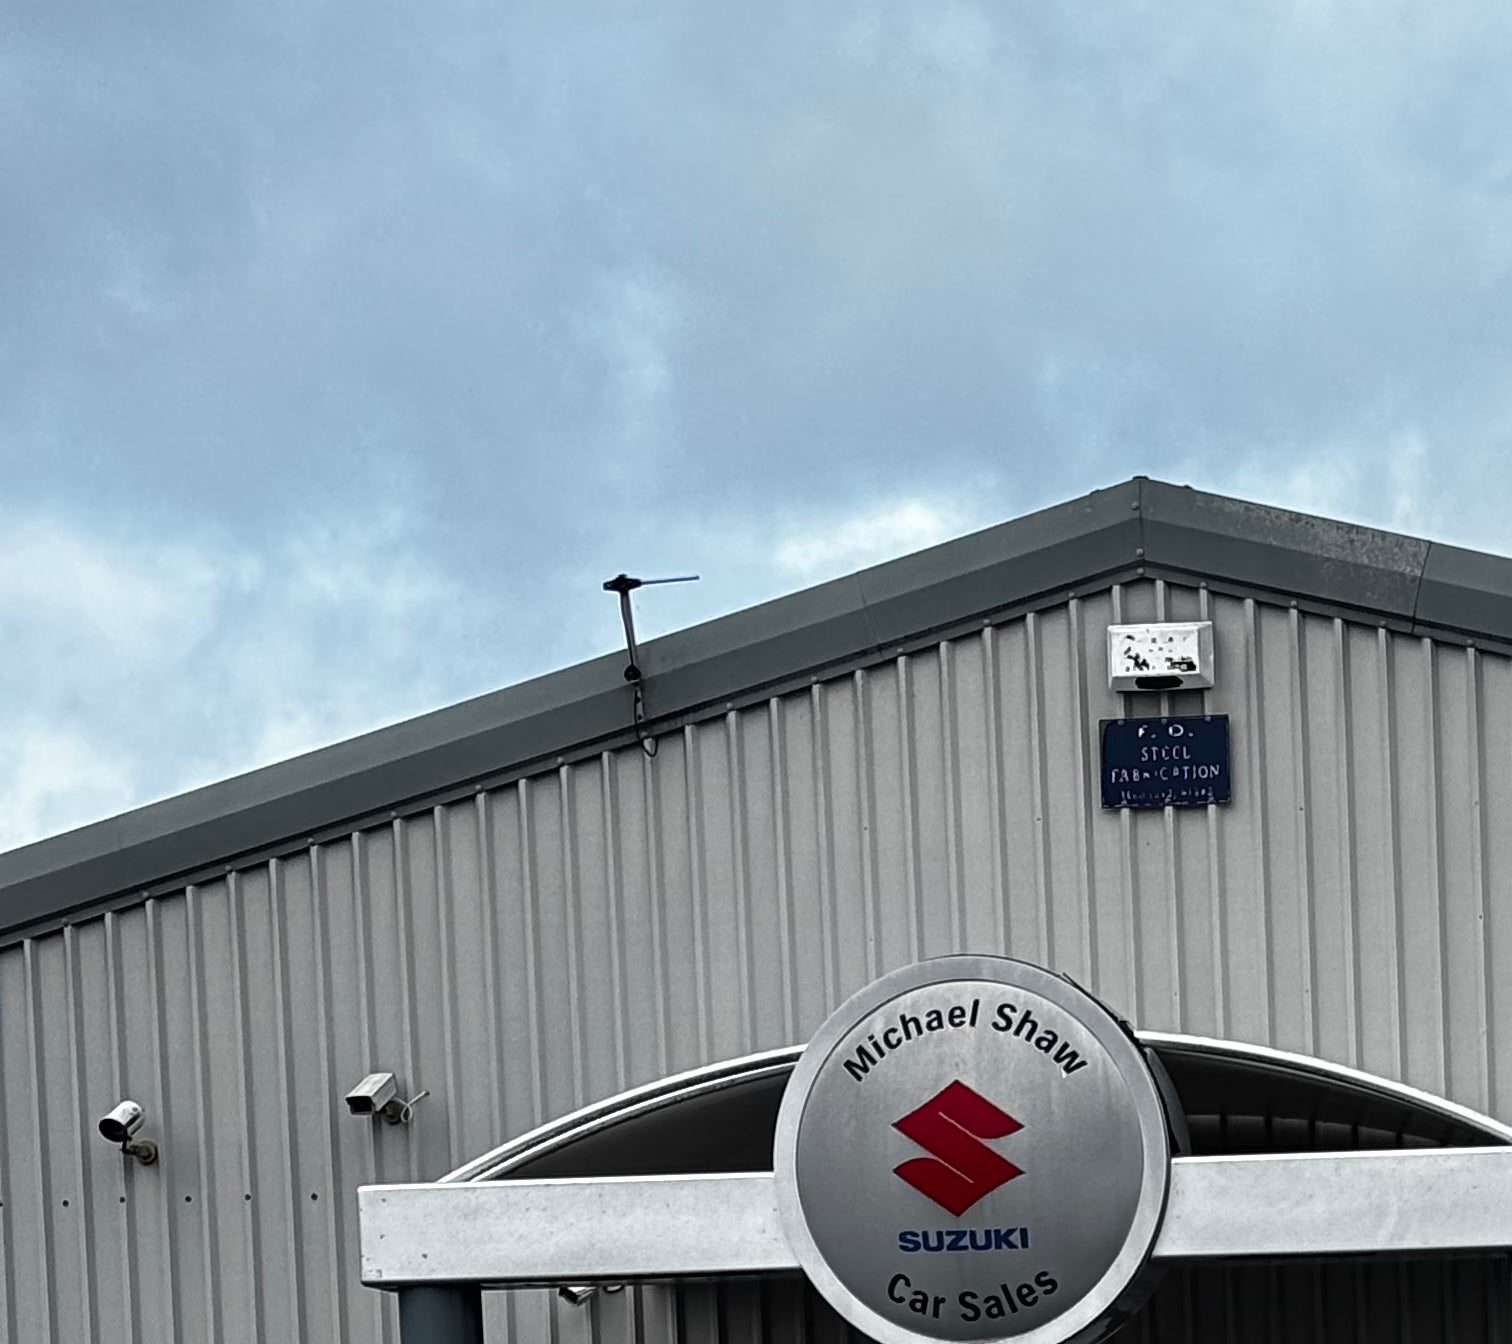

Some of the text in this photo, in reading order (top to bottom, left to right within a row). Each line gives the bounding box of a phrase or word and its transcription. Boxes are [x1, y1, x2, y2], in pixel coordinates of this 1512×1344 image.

[1111, 764, 1220, 784] FABCATION
[842, 999, 1088, 1082] Michael Shaw
[898, 1227, 1030, 1252] SUZUKI
[887, 1270, 1058, 1322] Car Sales
